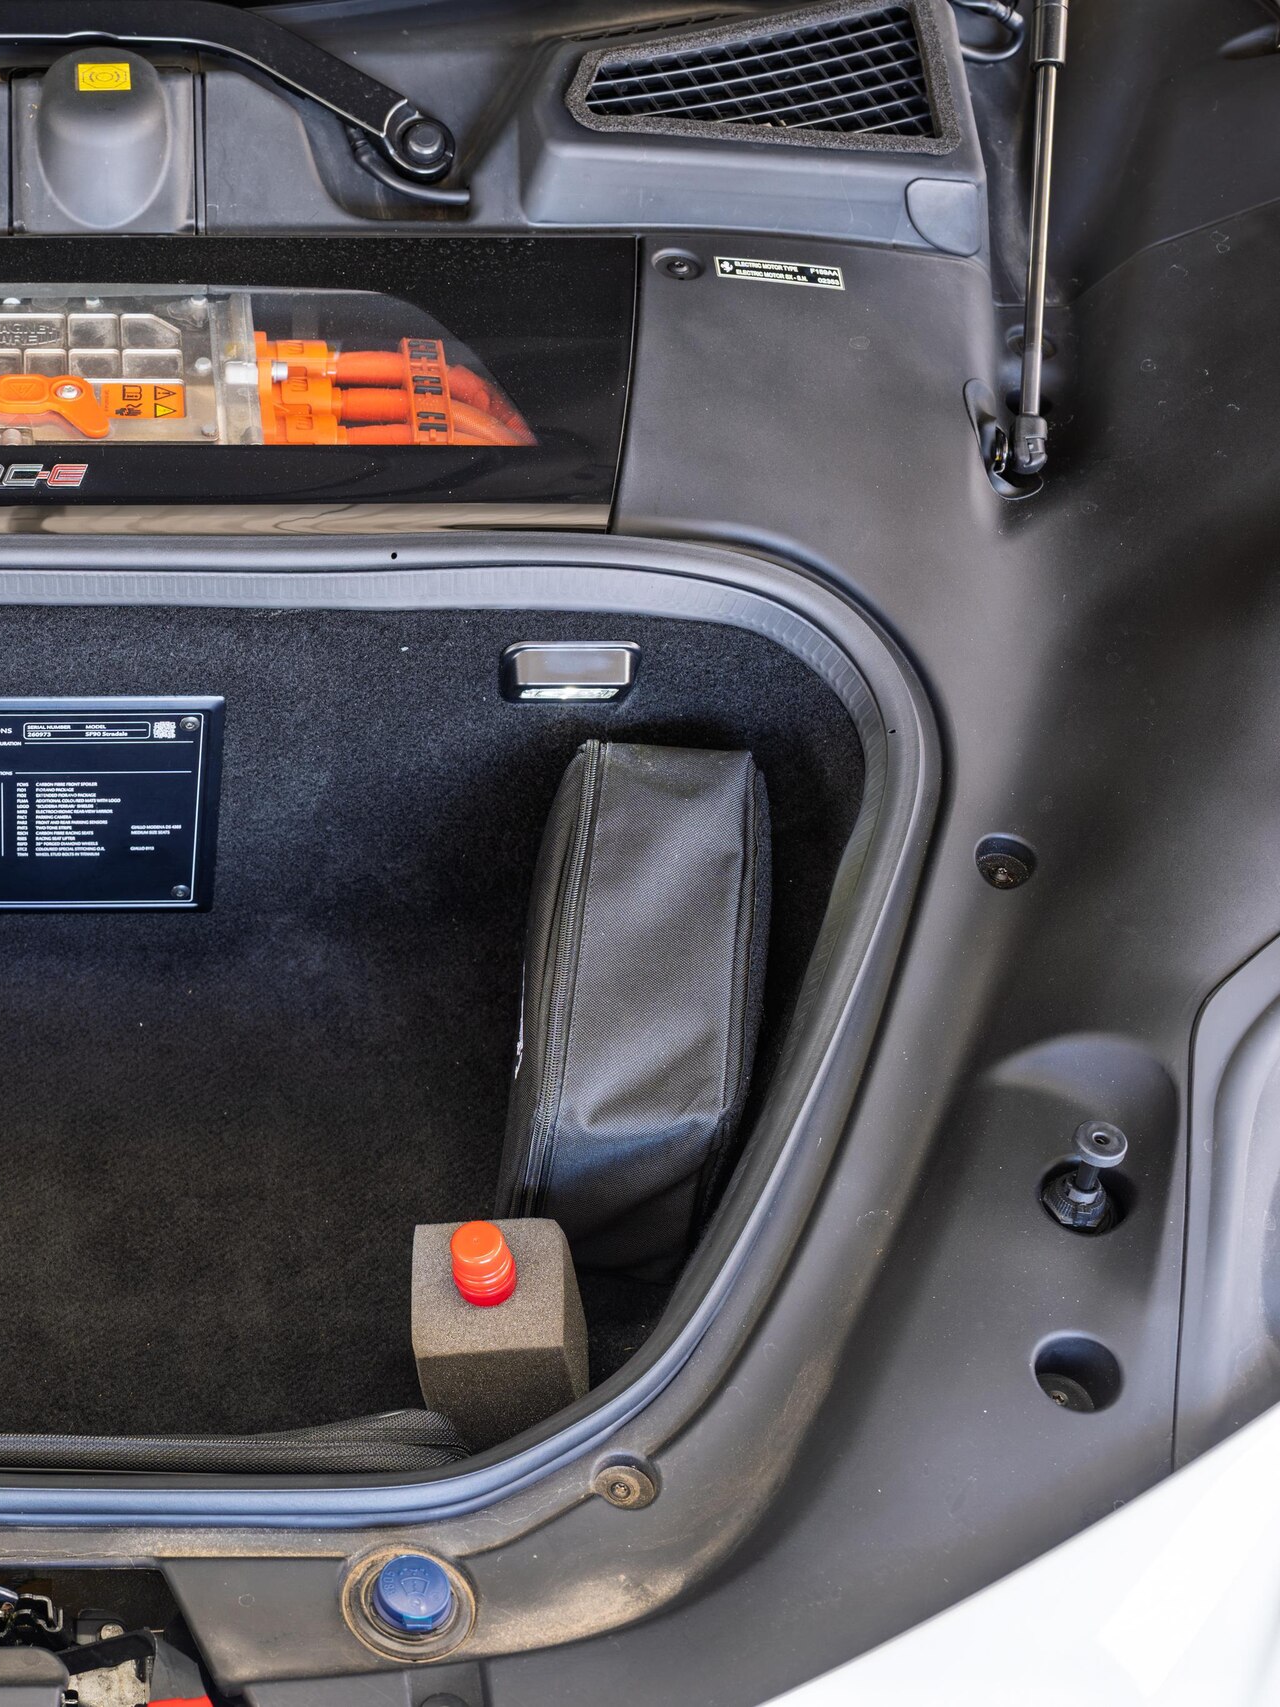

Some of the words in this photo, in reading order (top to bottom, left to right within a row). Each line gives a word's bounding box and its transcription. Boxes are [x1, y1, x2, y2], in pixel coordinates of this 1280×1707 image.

[734, 261, 761, 269] ELECTRIC
[762, 263, 783, 271] MOTOR
[736, 269, 763, 277] ELECTRIC
[764, 271, 784, 279] MOTOR
